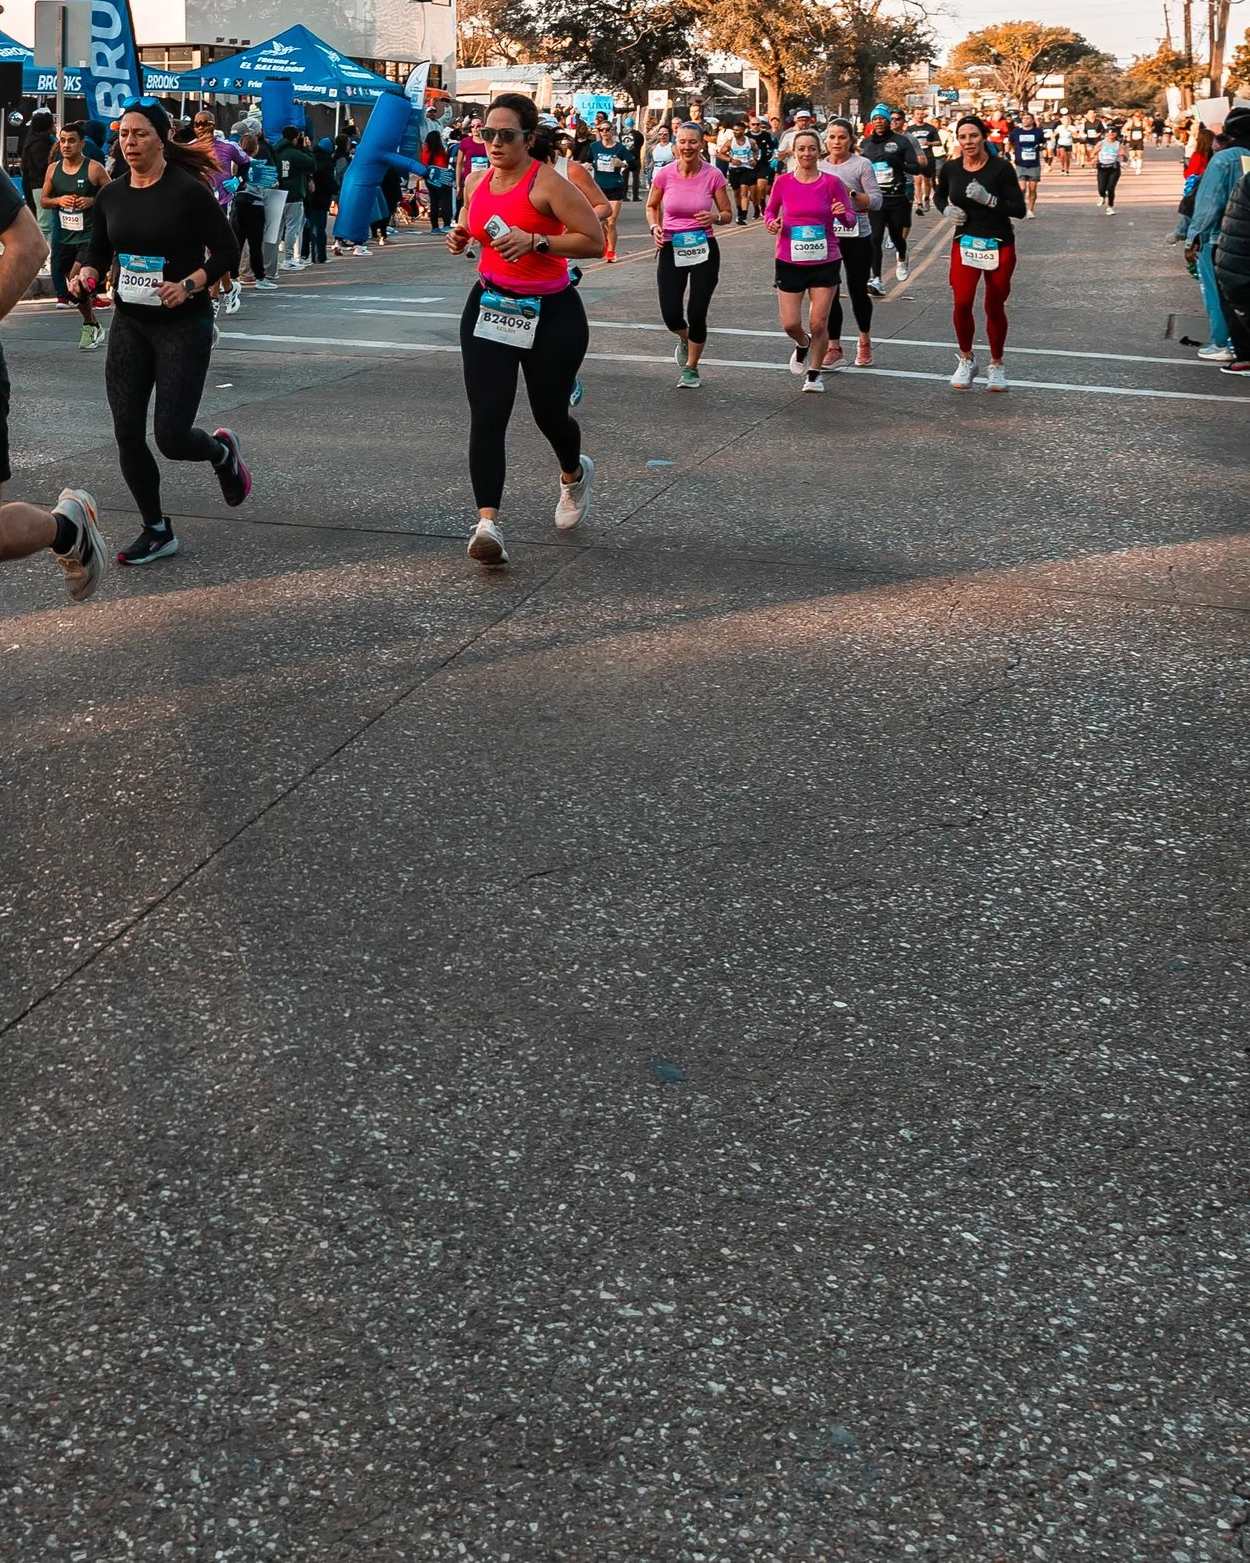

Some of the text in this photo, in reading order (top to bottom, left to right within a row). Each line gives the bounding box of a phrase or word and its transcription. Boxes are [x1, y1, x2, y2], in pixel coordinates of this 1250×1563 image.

[239, 61, 252, 70] EL
[146, 74, 180, 90] BROOKS
[678, 248, 706, 256] C30828
[484, 312, 532, 331] B24098
